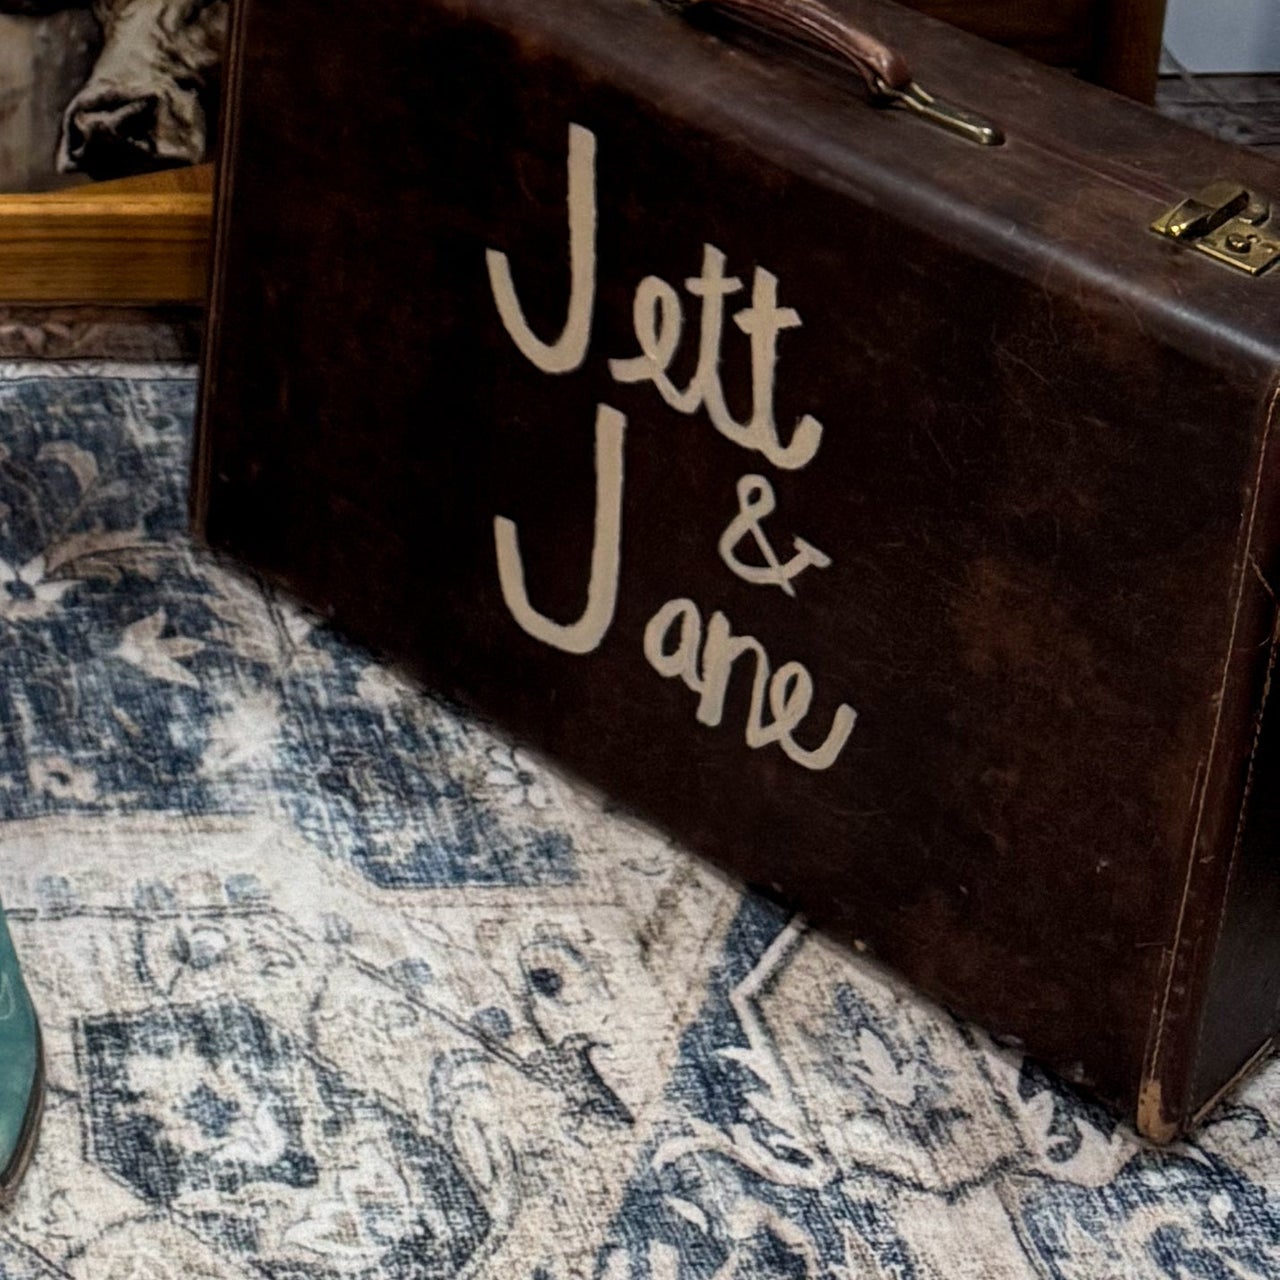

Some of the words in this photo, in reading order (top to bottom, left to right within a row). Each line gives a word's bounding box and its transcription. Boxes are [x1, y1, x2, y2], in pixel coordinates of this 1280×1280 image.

[487, 124, 824, 470] Jett
[494, 405, 858, 770] Jane
[720, 474, 831, 596] &
